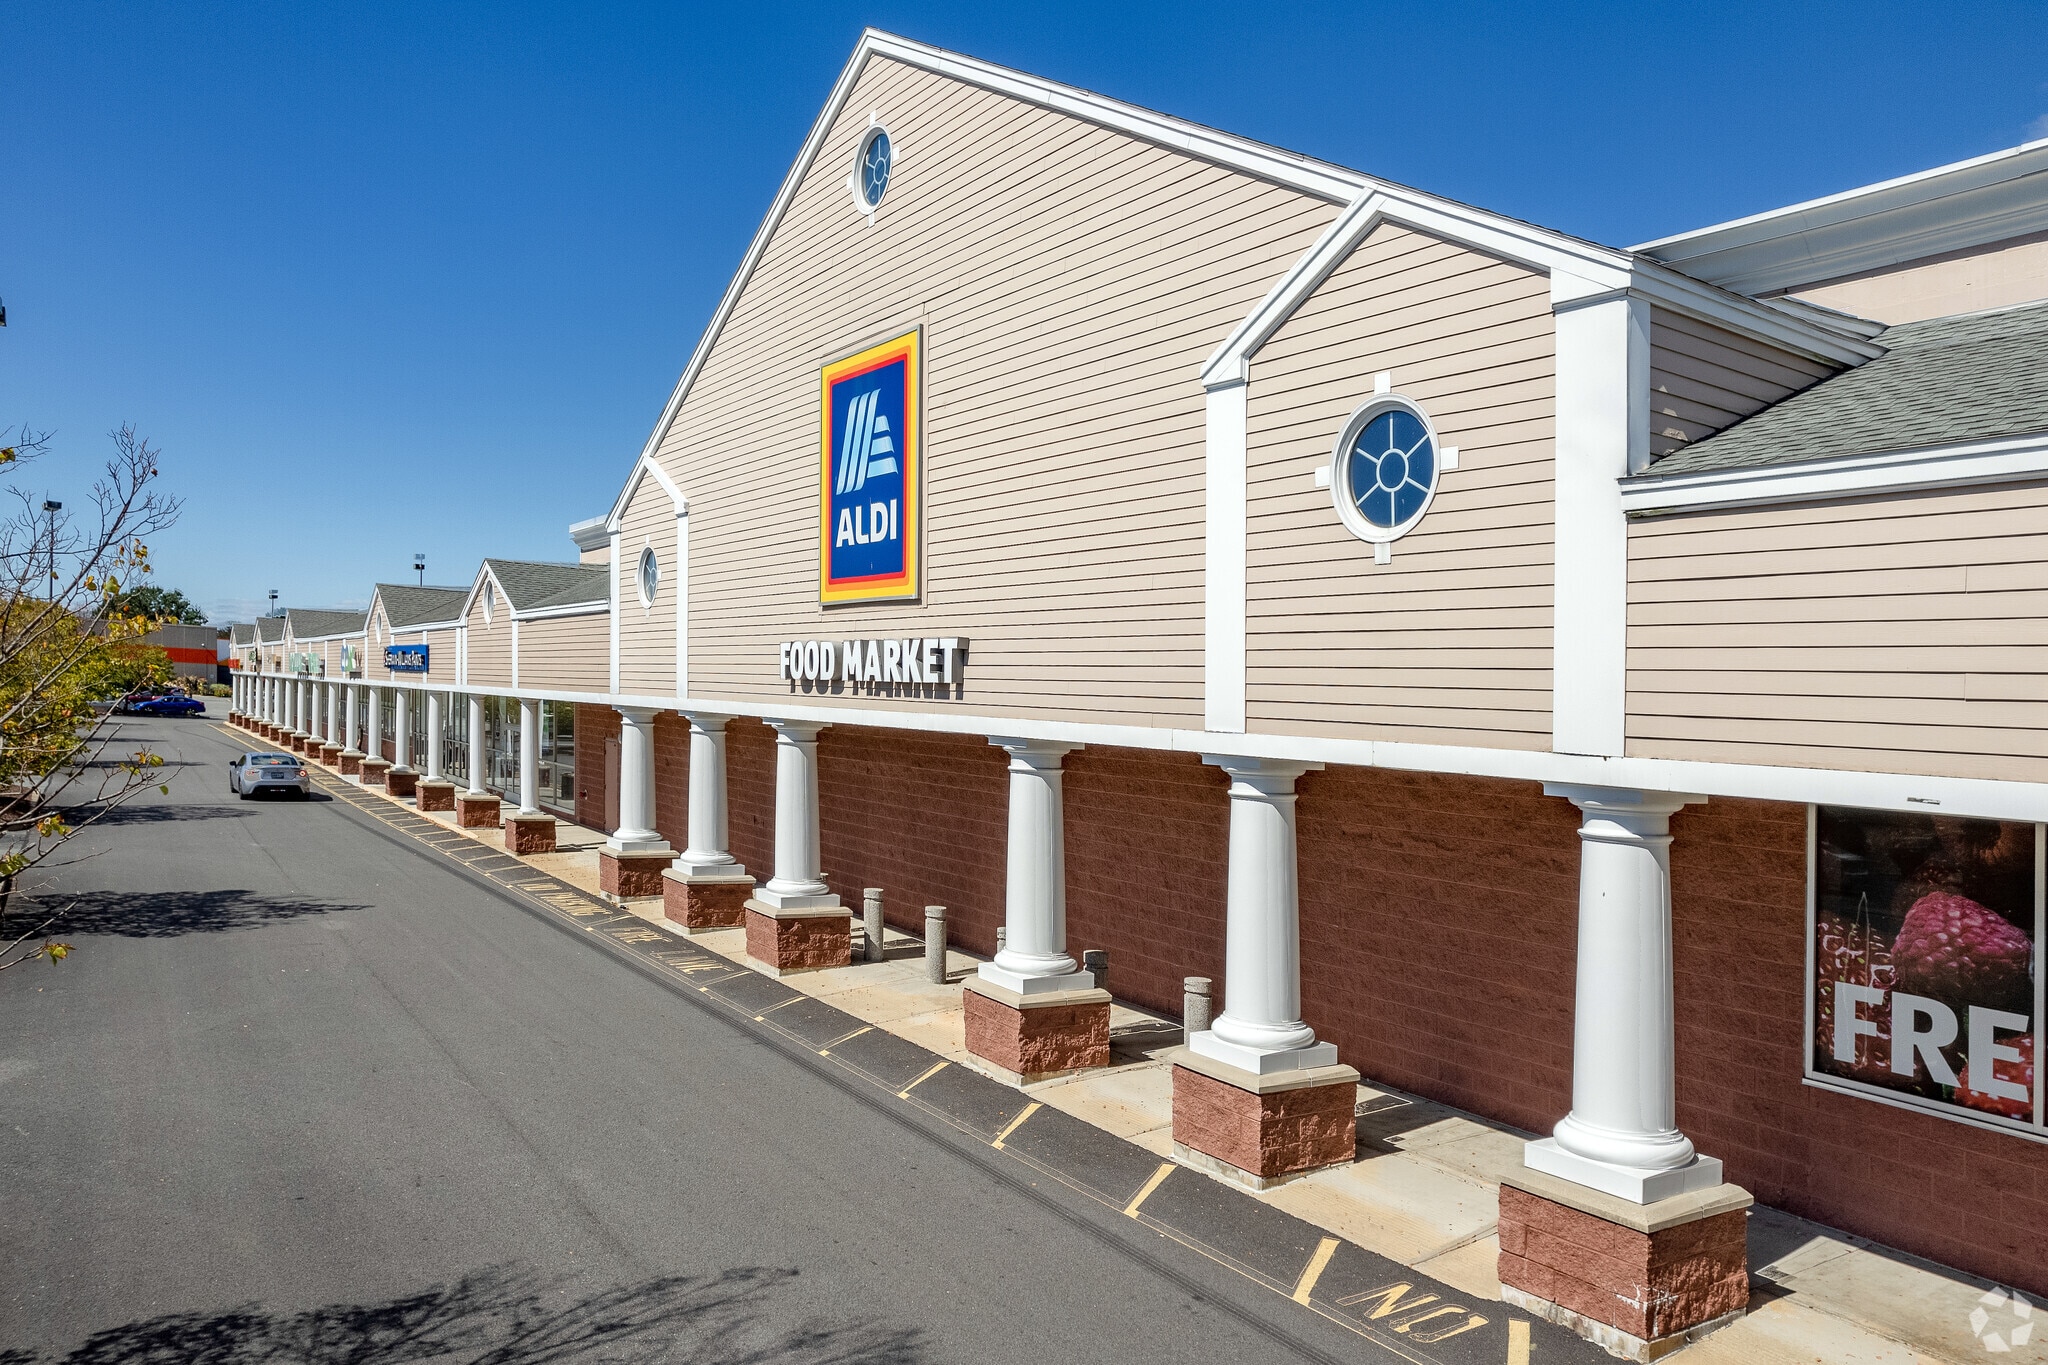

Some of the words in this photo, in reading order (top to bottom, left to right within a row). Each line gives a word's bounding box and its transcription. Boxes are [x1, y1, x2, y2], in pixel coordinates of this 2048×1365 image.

[836, 498, 897, 548] ALDI
[779, 640, 836, 681] FOOD
[841, 637, 959, 684] MARKET
[1833, 980, 2030, 1104] FRE
[1335, 1281, 1490, 1344] NO
